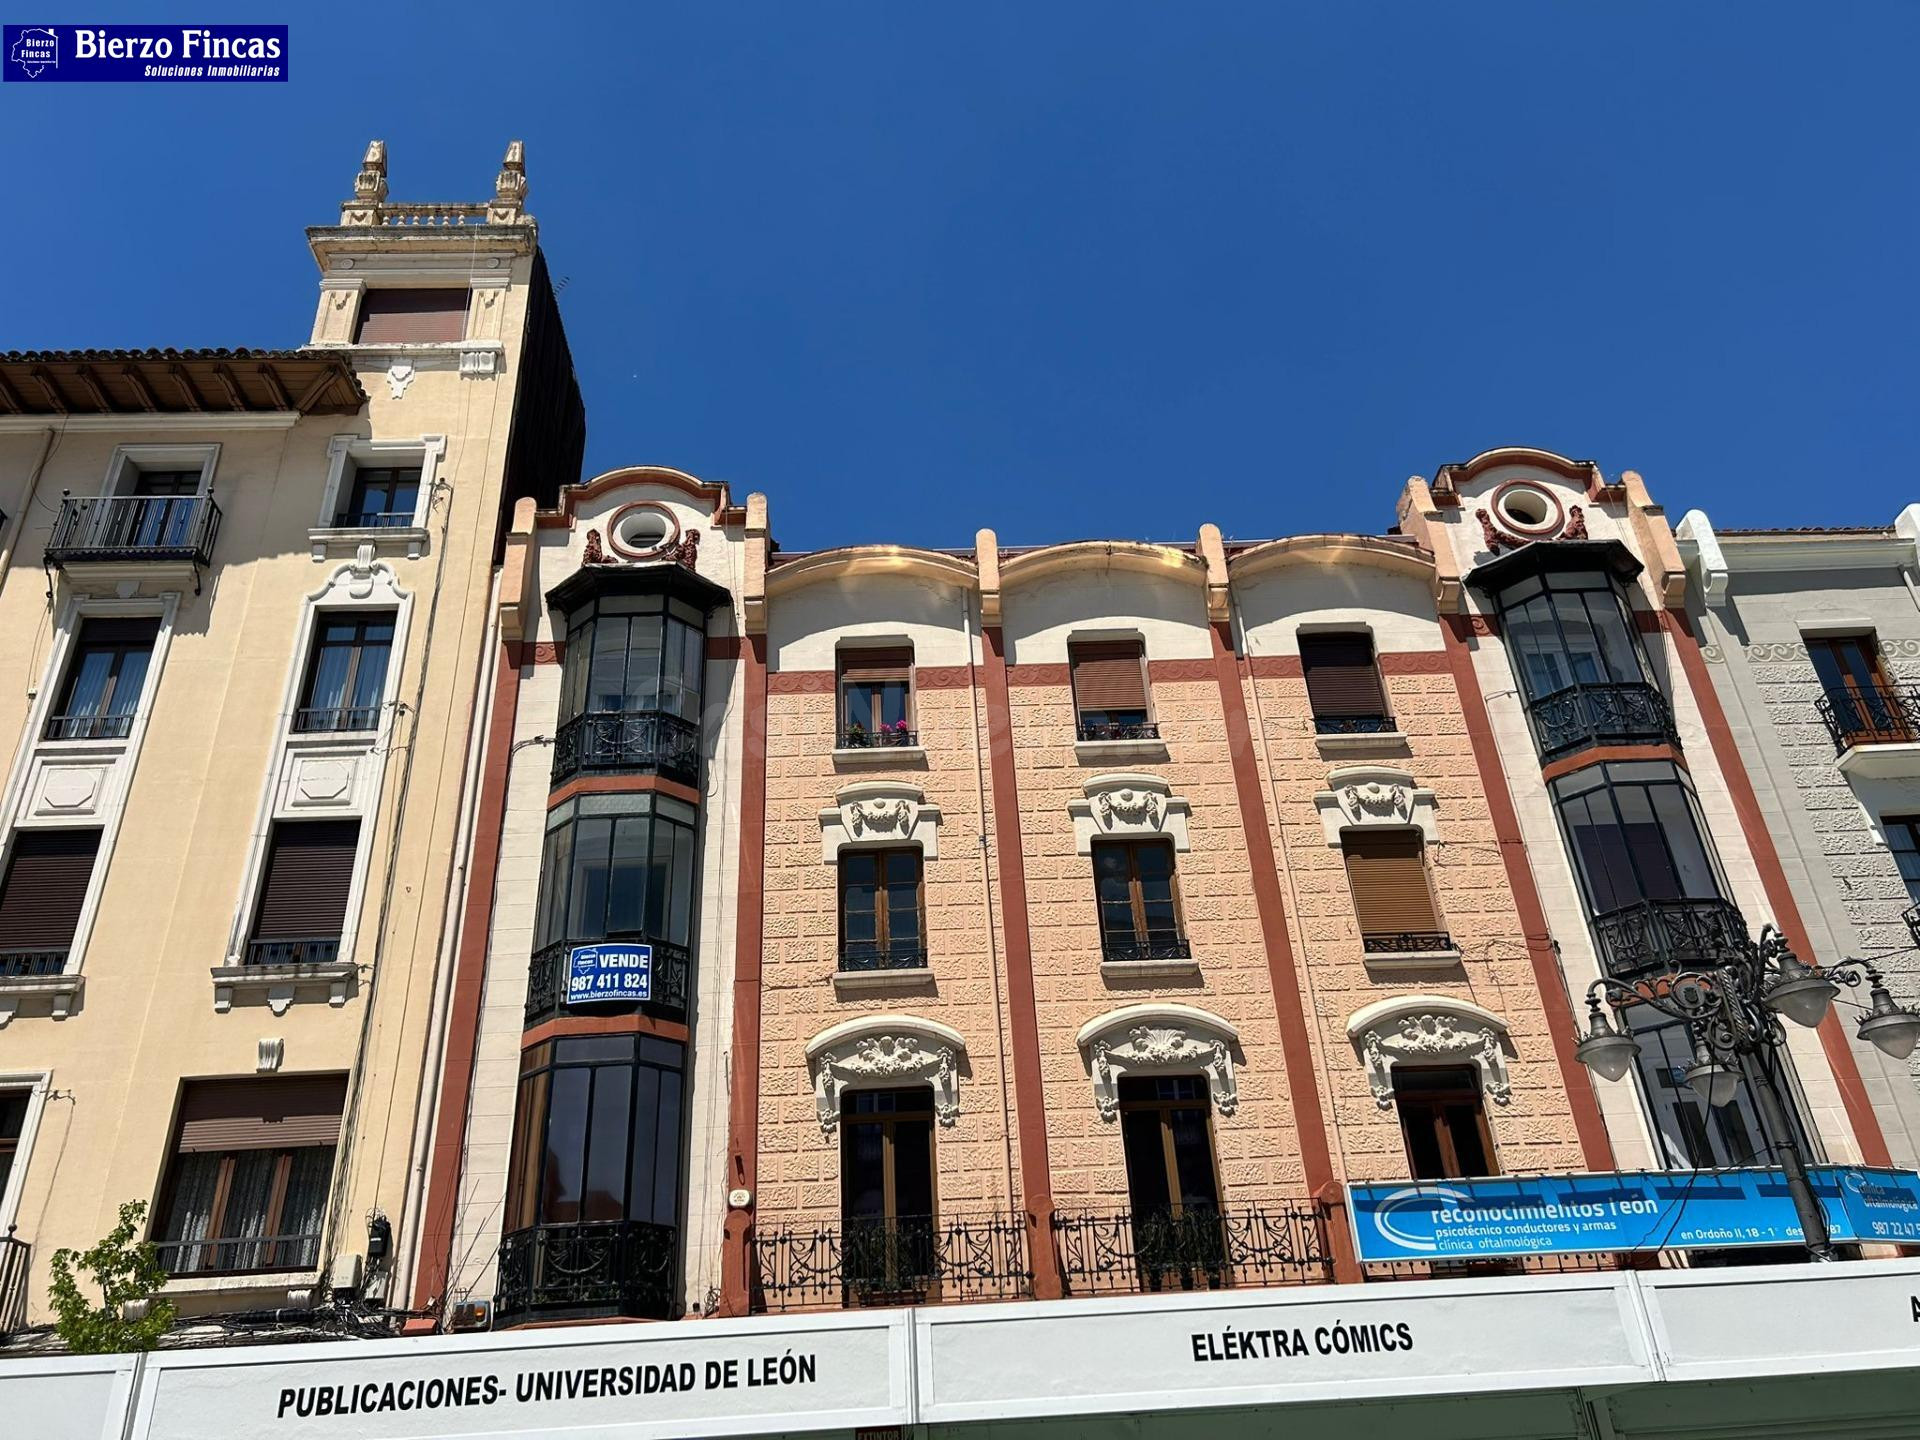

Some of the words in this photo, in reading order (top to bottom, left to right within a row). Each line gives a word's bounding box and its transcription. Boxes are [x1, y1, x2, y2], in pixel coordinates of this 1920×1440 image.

[599, 954, 648, 968] VENDE
[571, 975, 594, 991] 987
[597, 973, 619, 988] 411
[624, 973, 647, 988] 824
[570, 989, 647, 1000] www.bierzofincas.es
[1431, 1200, 1605, 1223] reconocimientos
[1435, 1224, 1502, 1240] psicotécnico
[1504, 1222, 1571, 1234] conductores
[1572, 1224, 1580, 1235] y
[1582, 1221, 1617, 1231] armas
[1680, 1231, 1694, 1240] en
[1695, 1228, 1734, 1239] Ordoño
[1745, 1227, 1760, 1238] 18
[1871, 1221, 1890, 1235] 987
[1890, 1221, 1905, 1235] 22
[1903, 1222, 1915, 1236] 47
[1438, 1238, 1474, 1251] clínica
[1478, 1235, 1553, 1250] oftalmológica
[1191, 1325, 1310, 1362] ELÉKTRA
[1314, 1319, 1413, 1355] CÓMICS
[277, 1375, 507, 1418] PUBLICACIONES-
[515, 1363, 696, 1402] UNIVERSIDAD
[704, 1359, 738, 1390] DE
[747, 1348, 816, 1387] LEÓN
